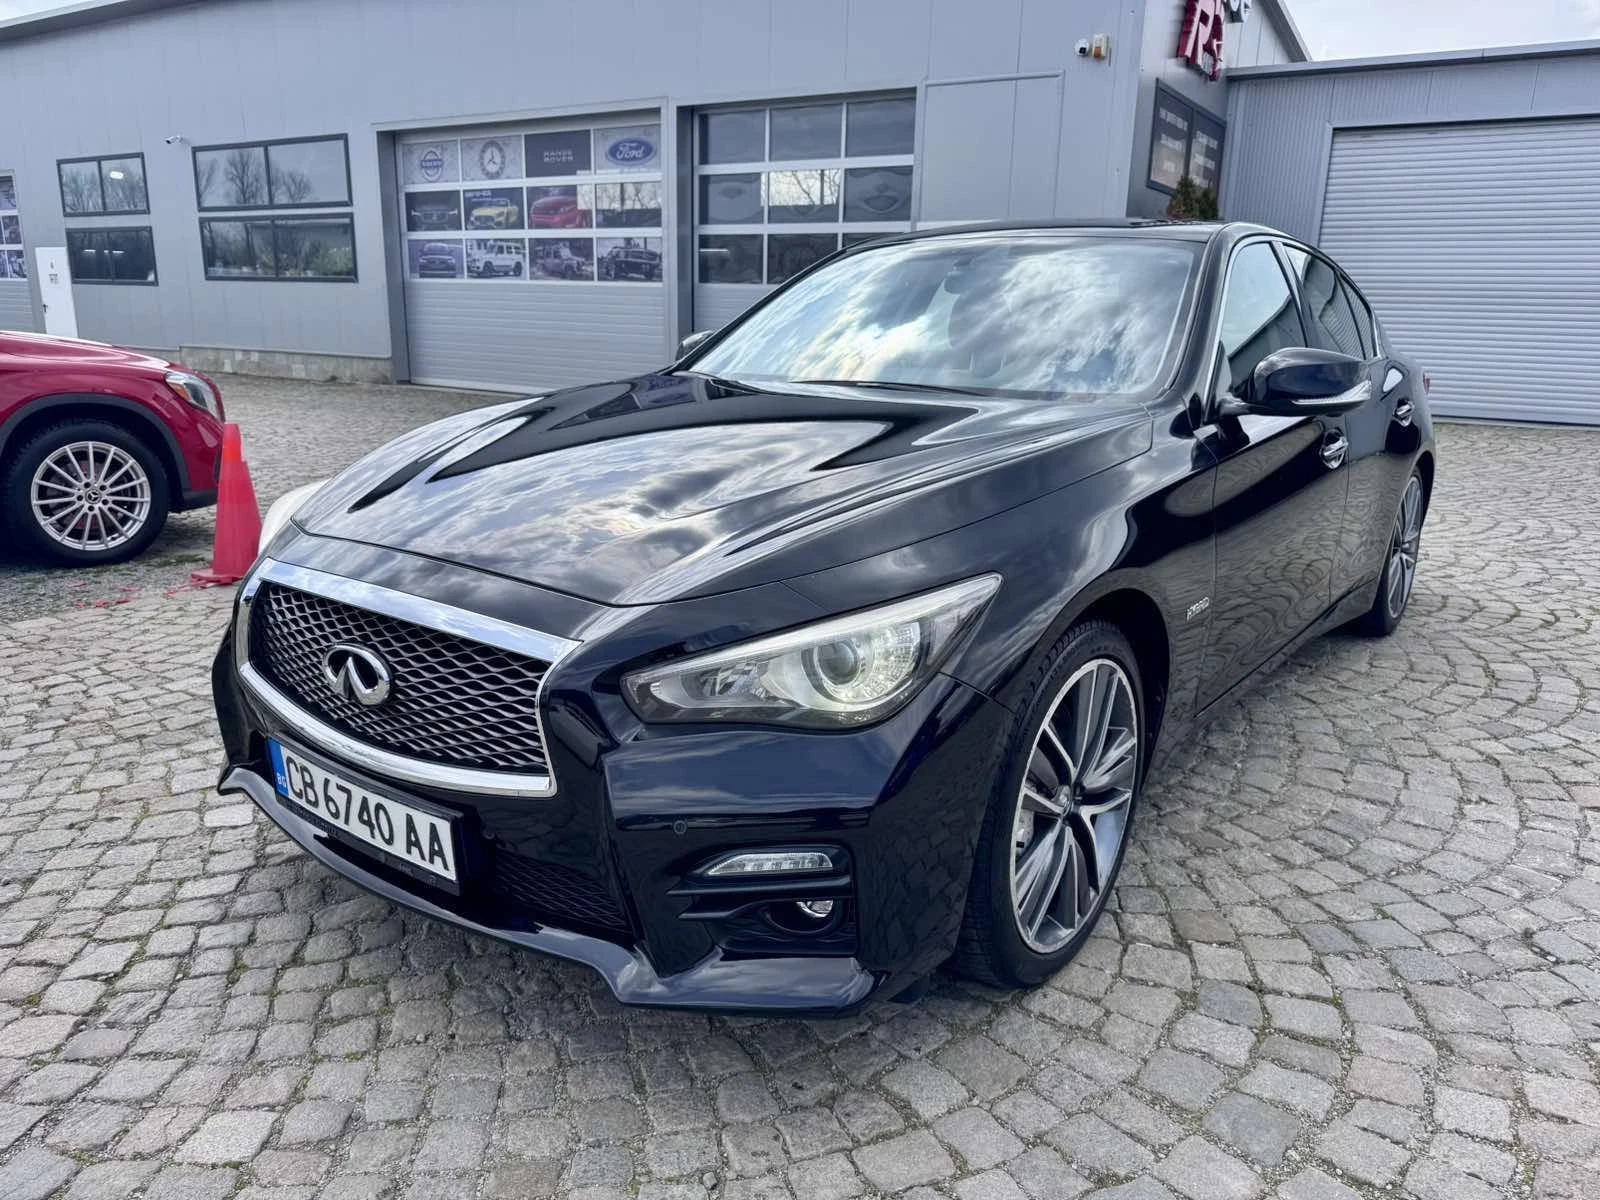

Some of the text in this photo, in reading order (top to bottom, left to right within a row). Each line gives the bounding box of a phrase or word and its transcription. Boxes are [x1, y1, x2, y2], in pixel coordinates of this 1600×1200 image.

[615, 142, 645, 160] Ford
[286, 755, 319, 809] CB
[323, 777, 394, 846] 6740
[405, 813, 449, 872] AA
